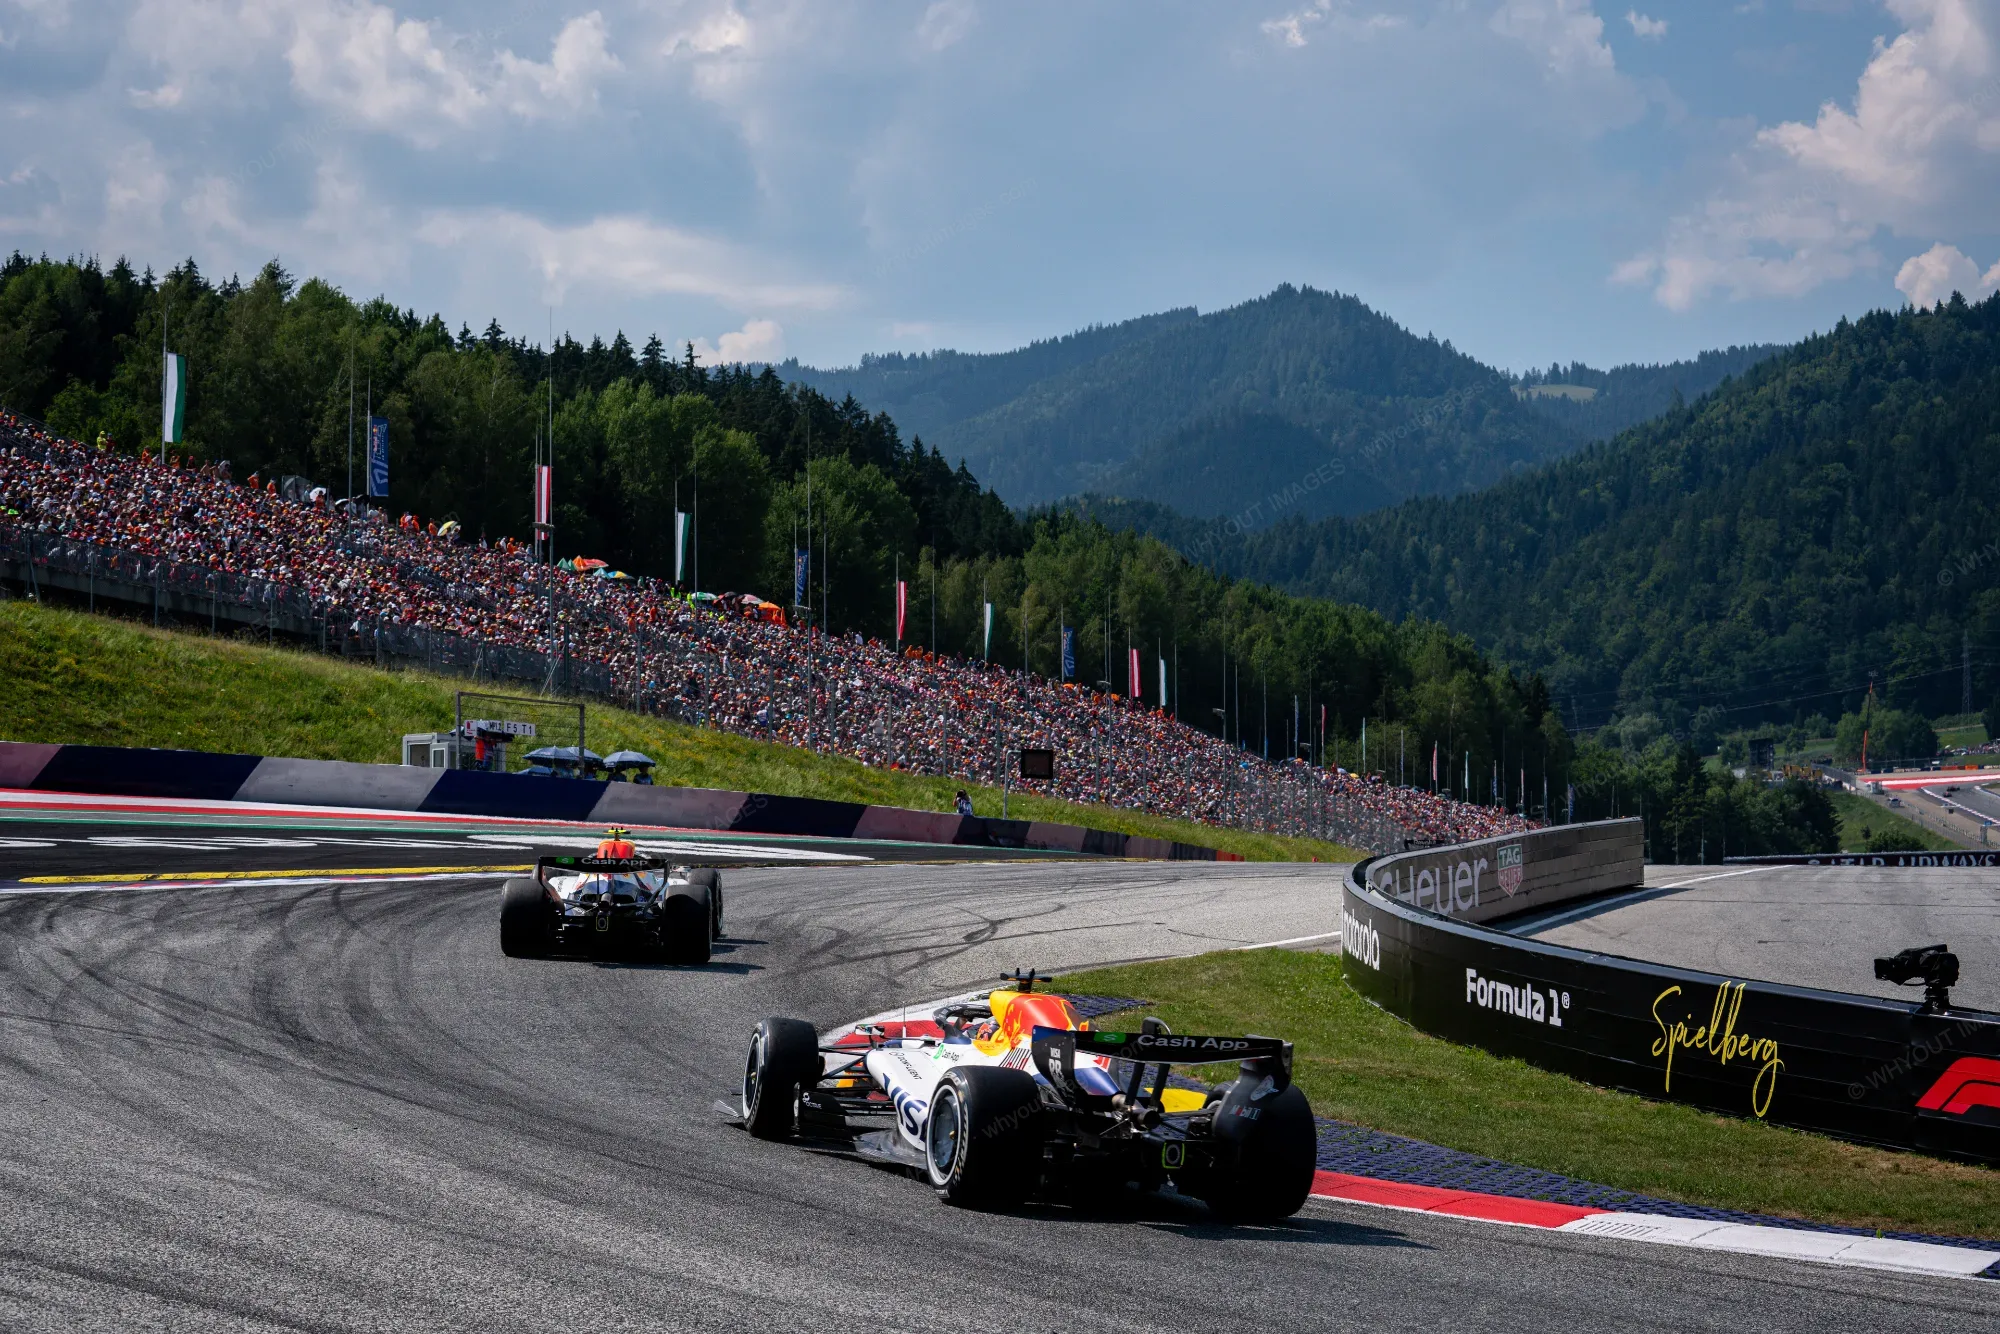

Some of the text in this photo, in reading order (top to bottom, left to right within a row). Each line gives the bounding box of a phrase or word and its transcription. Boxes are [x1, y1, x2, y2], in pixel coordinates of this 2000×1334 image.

[581, 857, 648, 867] Cash App
[1499, 846, 1522, 866] TAG
[1499, 866, 1523, 891] HEUER
[1466, 968, 1545, 1022] Formula
[1138, 1034, 1249, 1051] Cash App
[1652, 980, 1785, 1118] Spielberg
